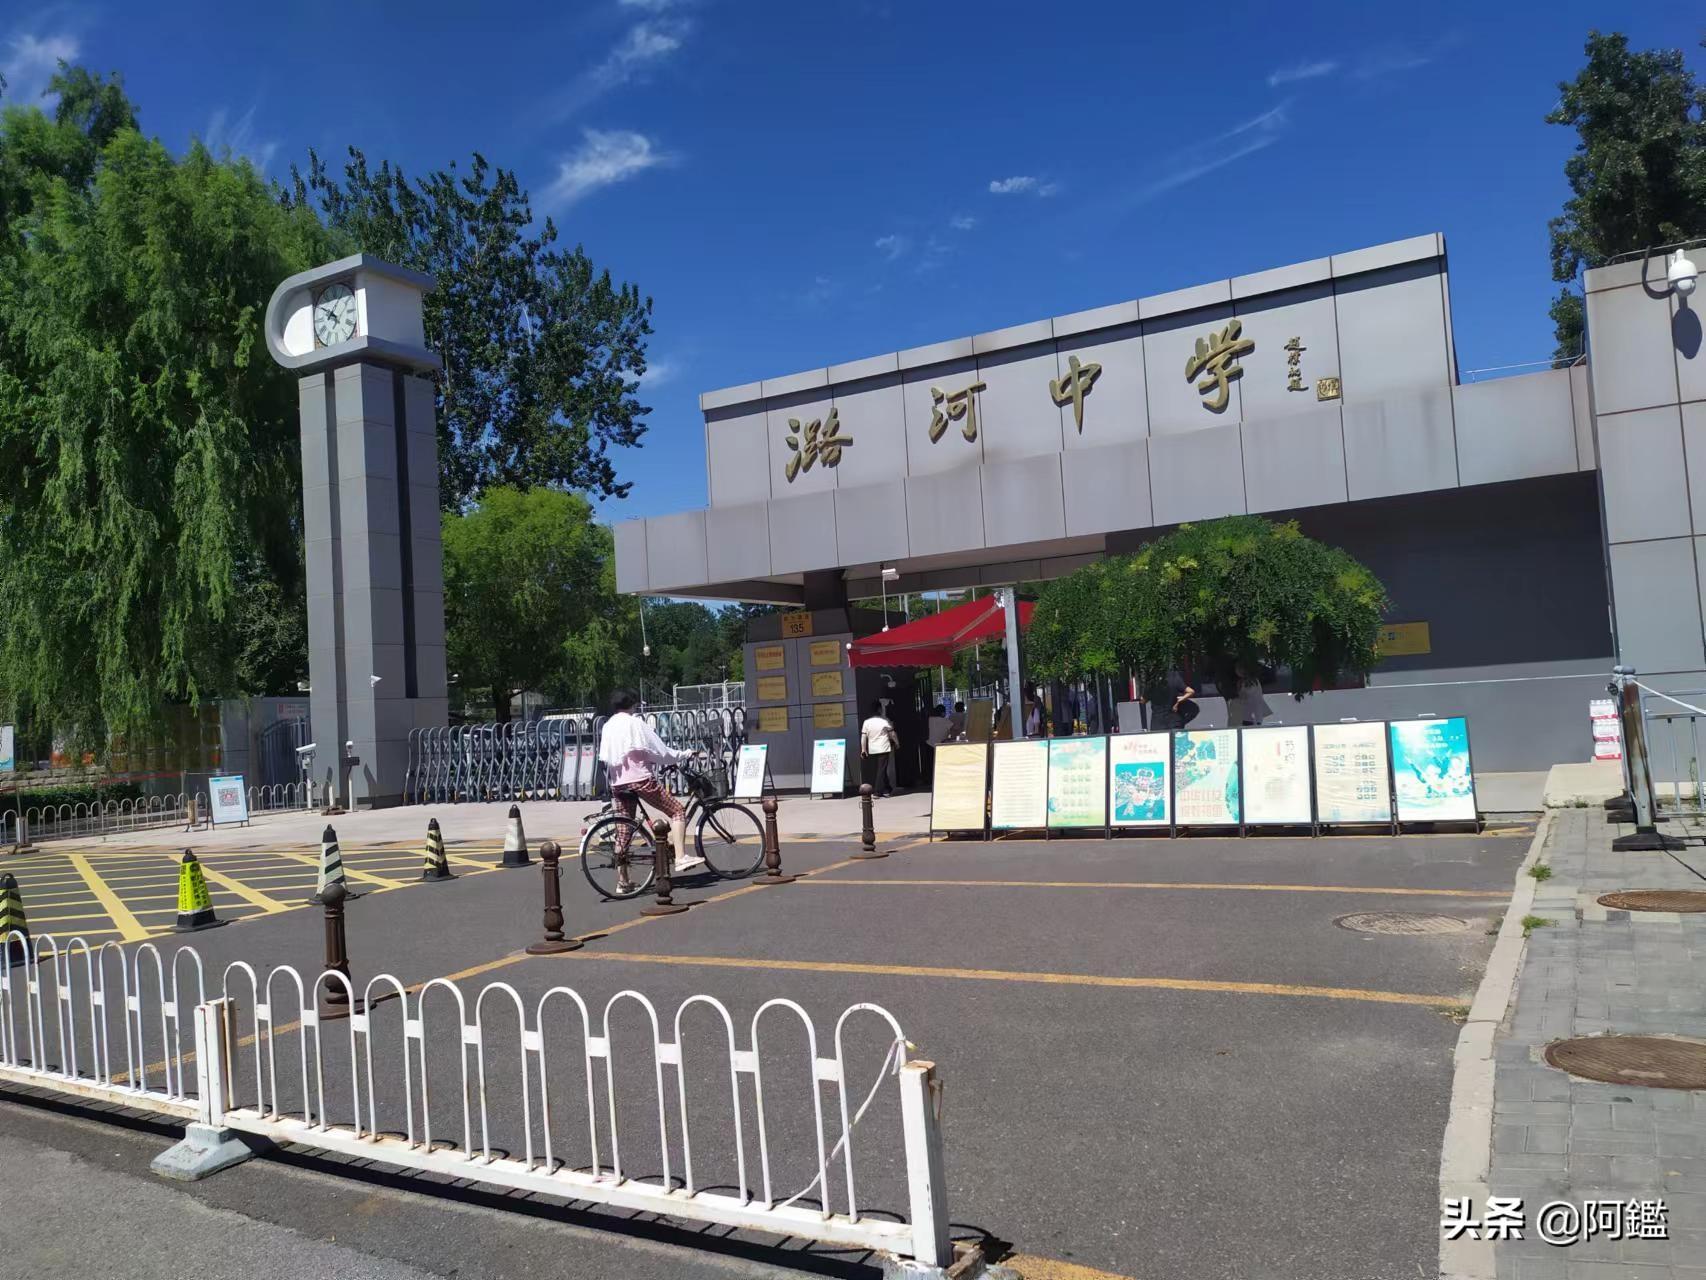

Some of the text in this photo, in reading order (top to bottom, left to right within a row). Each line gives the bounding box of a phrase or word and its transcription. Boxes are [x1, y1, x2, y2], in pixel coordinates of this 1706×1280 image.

[785, 319, 1255, 483] 潞河中学
[790, 623, 804, 634] 135
